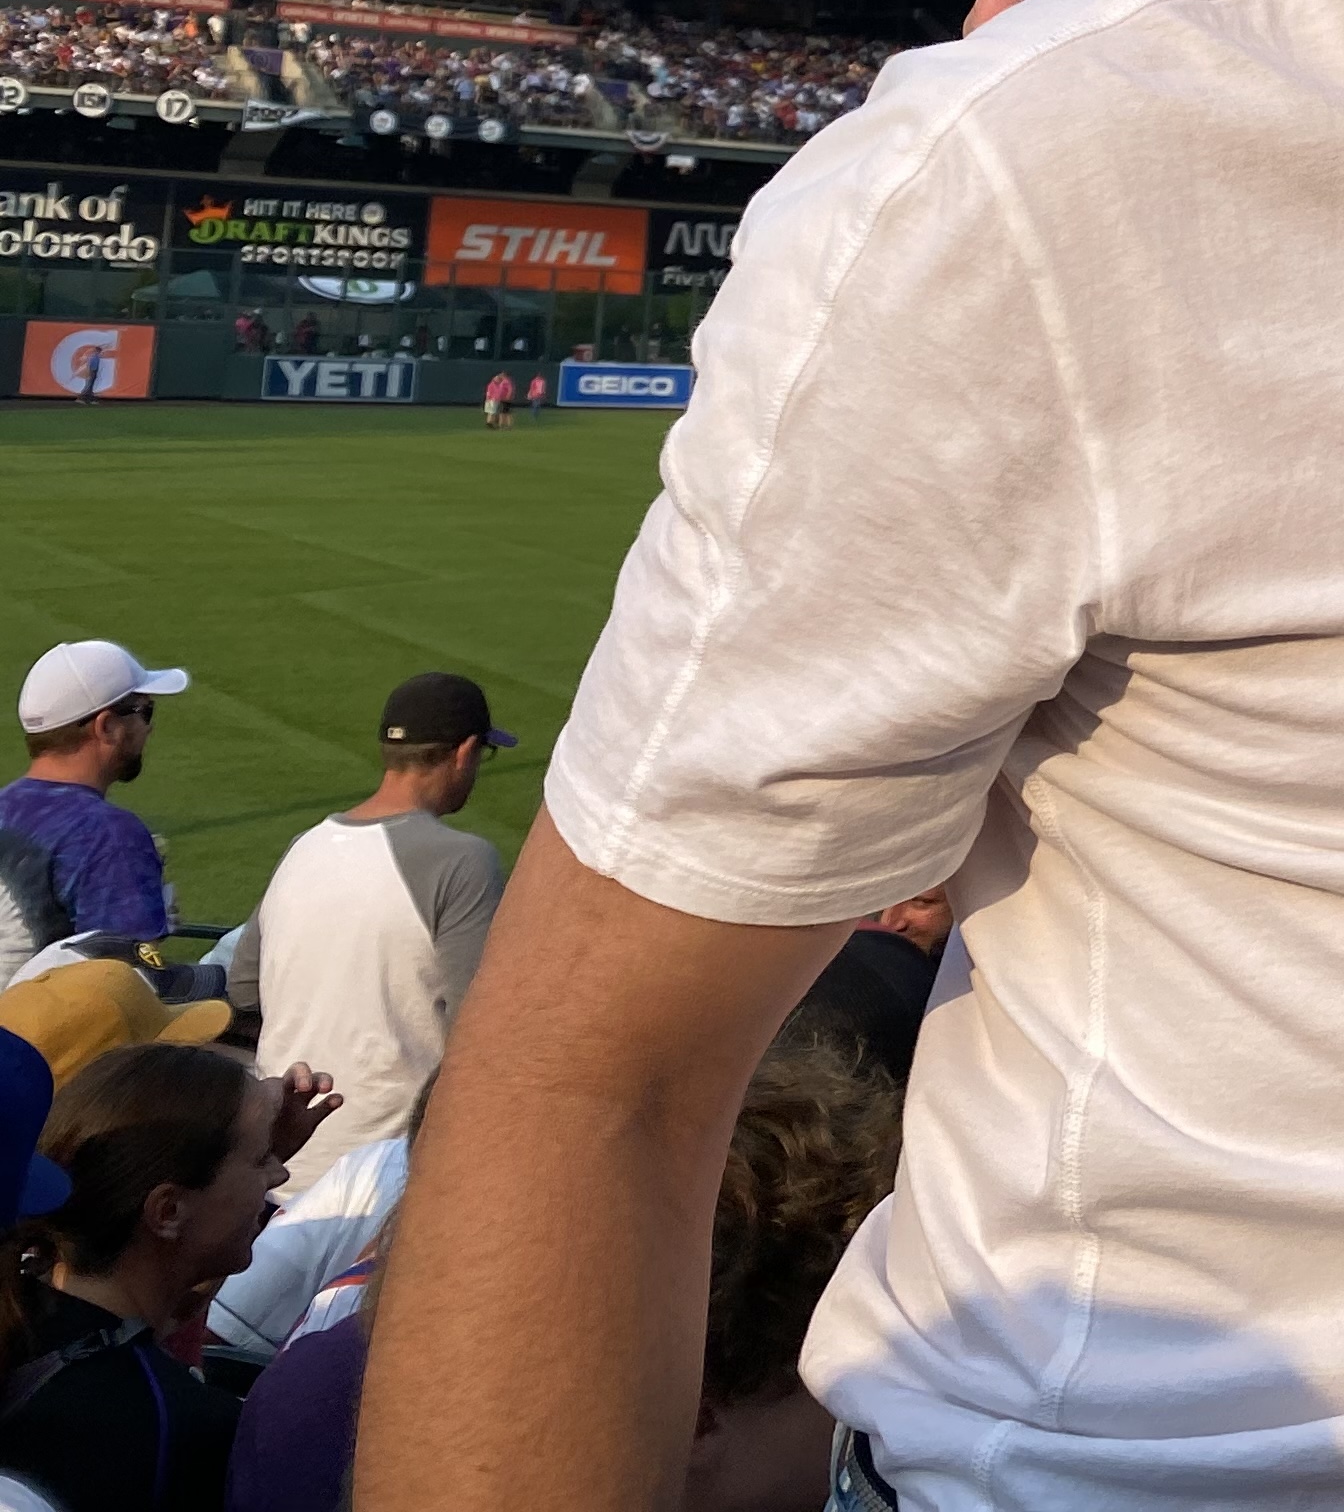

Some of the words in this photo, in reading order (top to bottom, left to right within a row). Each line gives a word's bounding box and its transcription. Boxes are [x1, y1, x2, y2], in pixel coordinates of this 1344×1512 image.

[0, 85, 19, 106] 2
[164, 97, 189, 118] 17
[78, 184, 129, 223] of
[243, 198, 280, 218] HIT
[282, 200, 306, 219] IT
[305, 201, 360, 222] HERE
[188, 218, 412, 250] DRAFTKINGS
[455, 224, 619, 268] STIHL
[277, 360, 406, 398] YETI
[578, 374, 675, 397] GEICO
